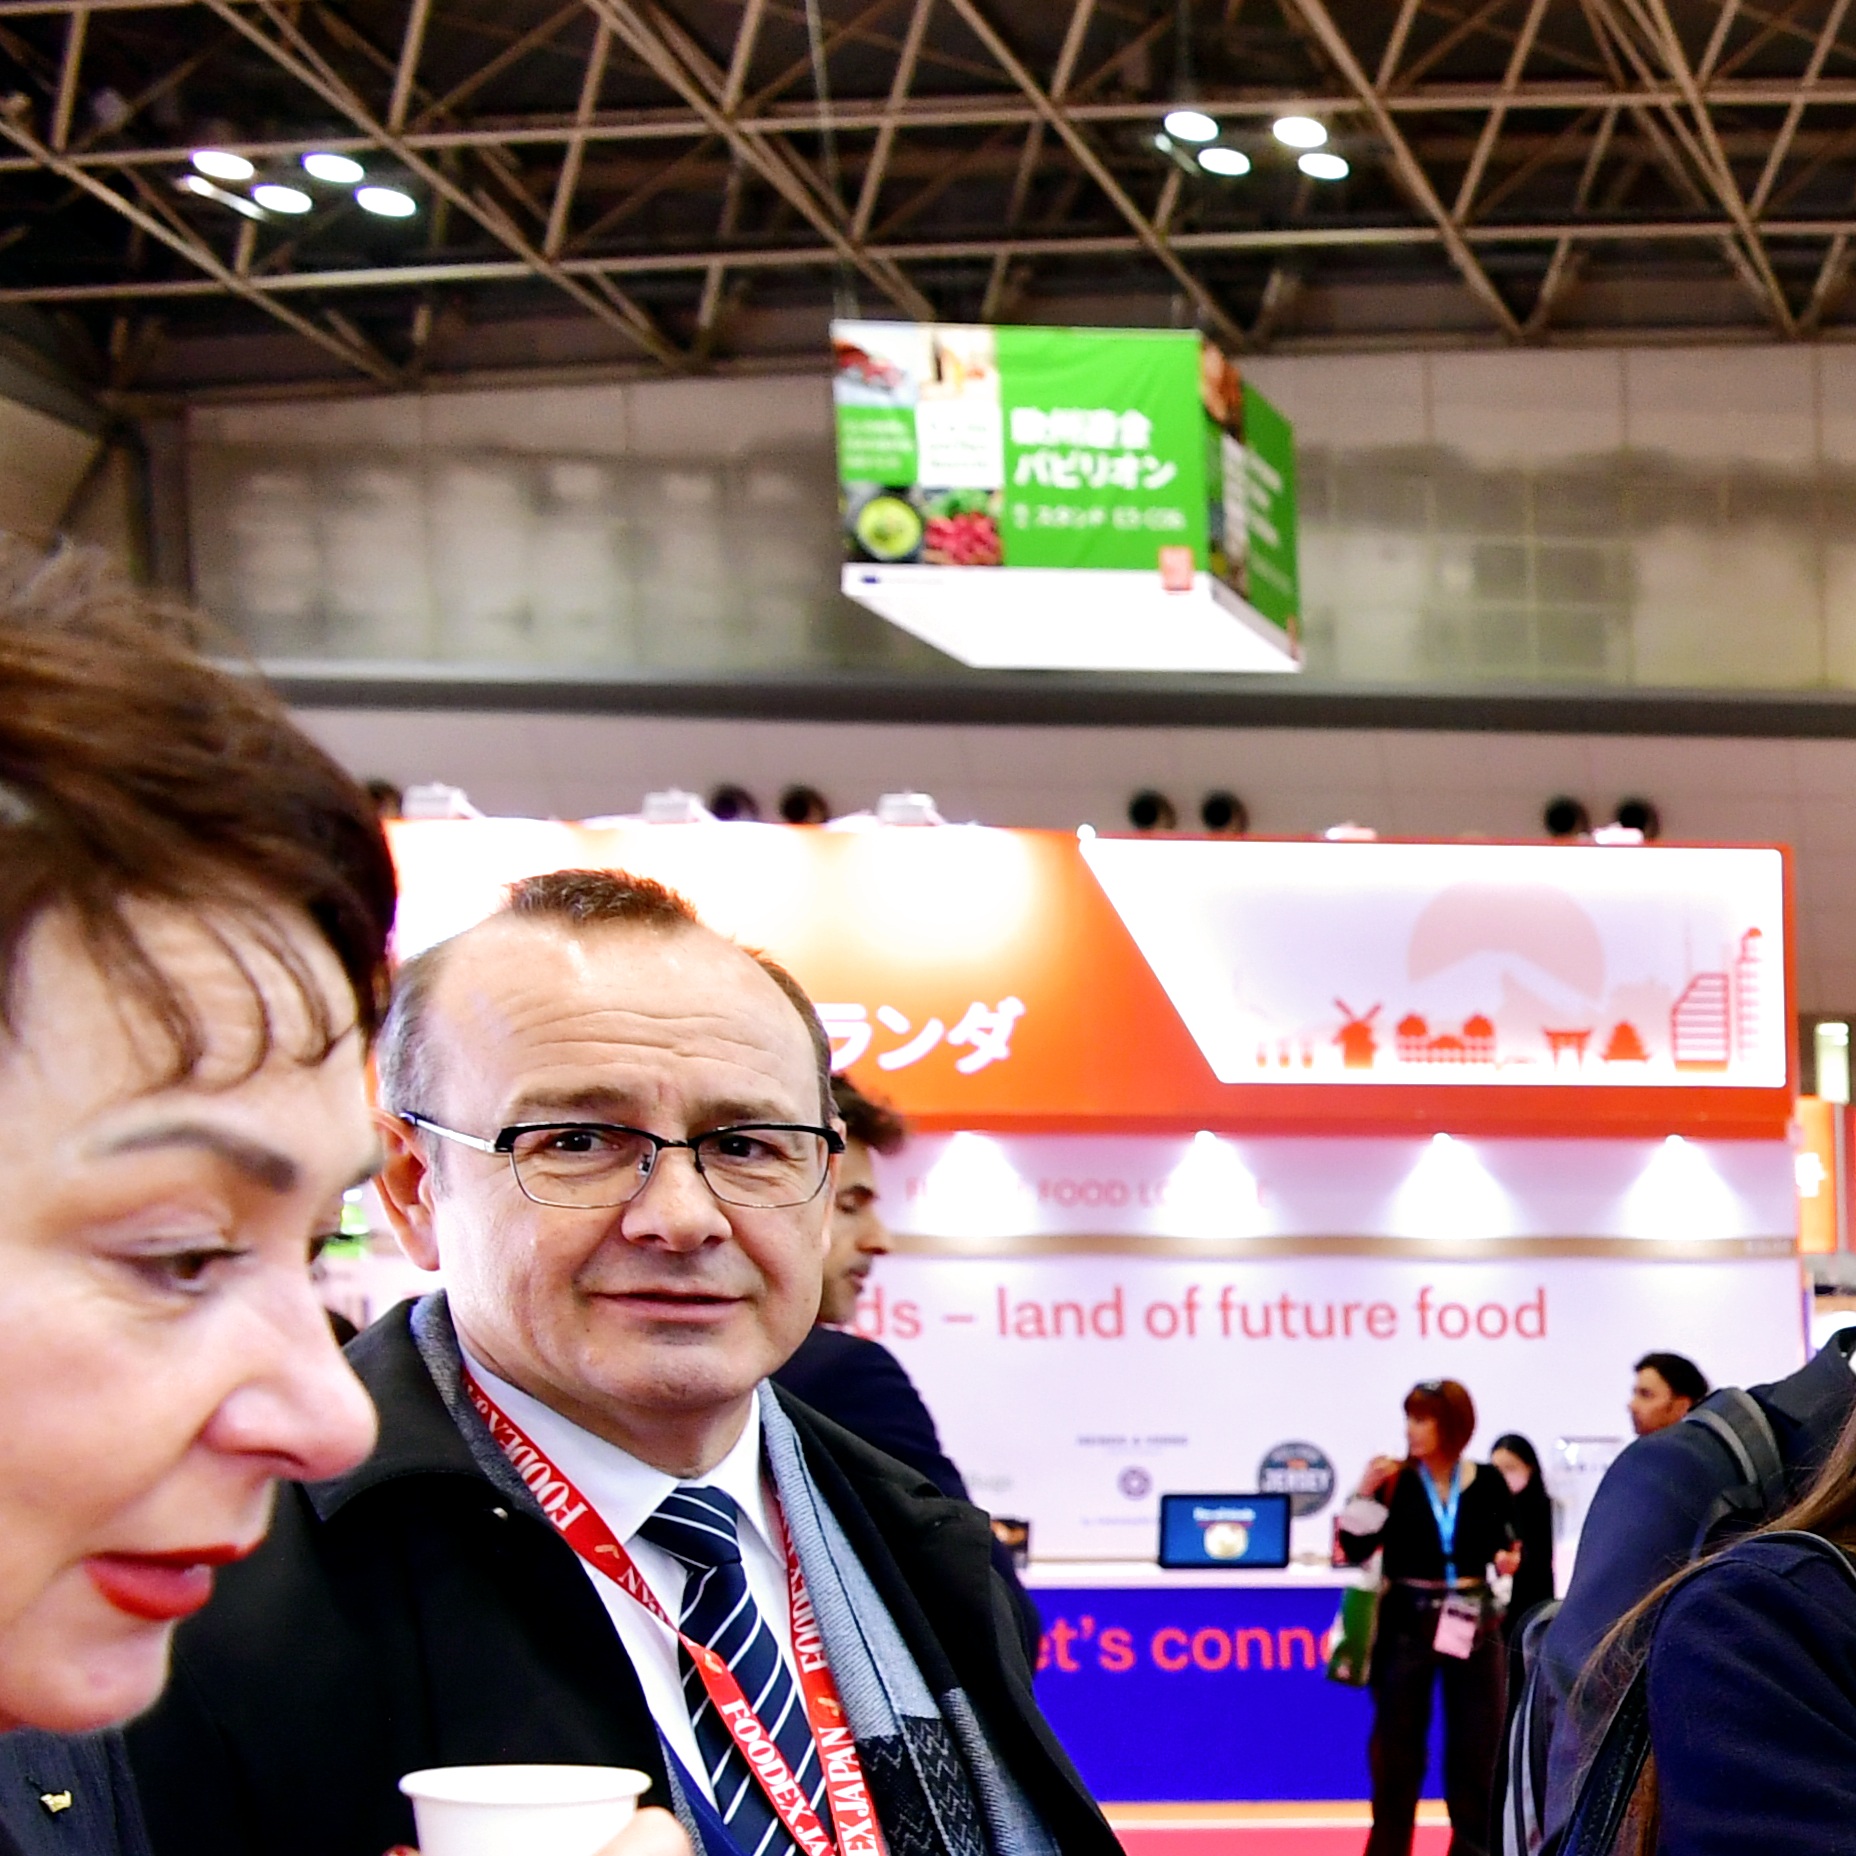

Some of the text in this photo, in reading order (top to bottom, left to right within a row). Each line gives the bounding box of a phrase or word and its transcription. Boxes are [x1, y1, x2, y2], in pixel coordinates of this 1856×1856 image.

[1013, 449, 1178, 492] パビリオン
[995, 1286, 1125, 1339] land
[1144, 1286, 1202, 1339] of
[1220, 1286, 1398, 1341] future
[1415, 1286, 1548, 1340] food
[720, 1698, 814, 1827] FOODEX
[818, 1726, 871, 1817] JAPAN
